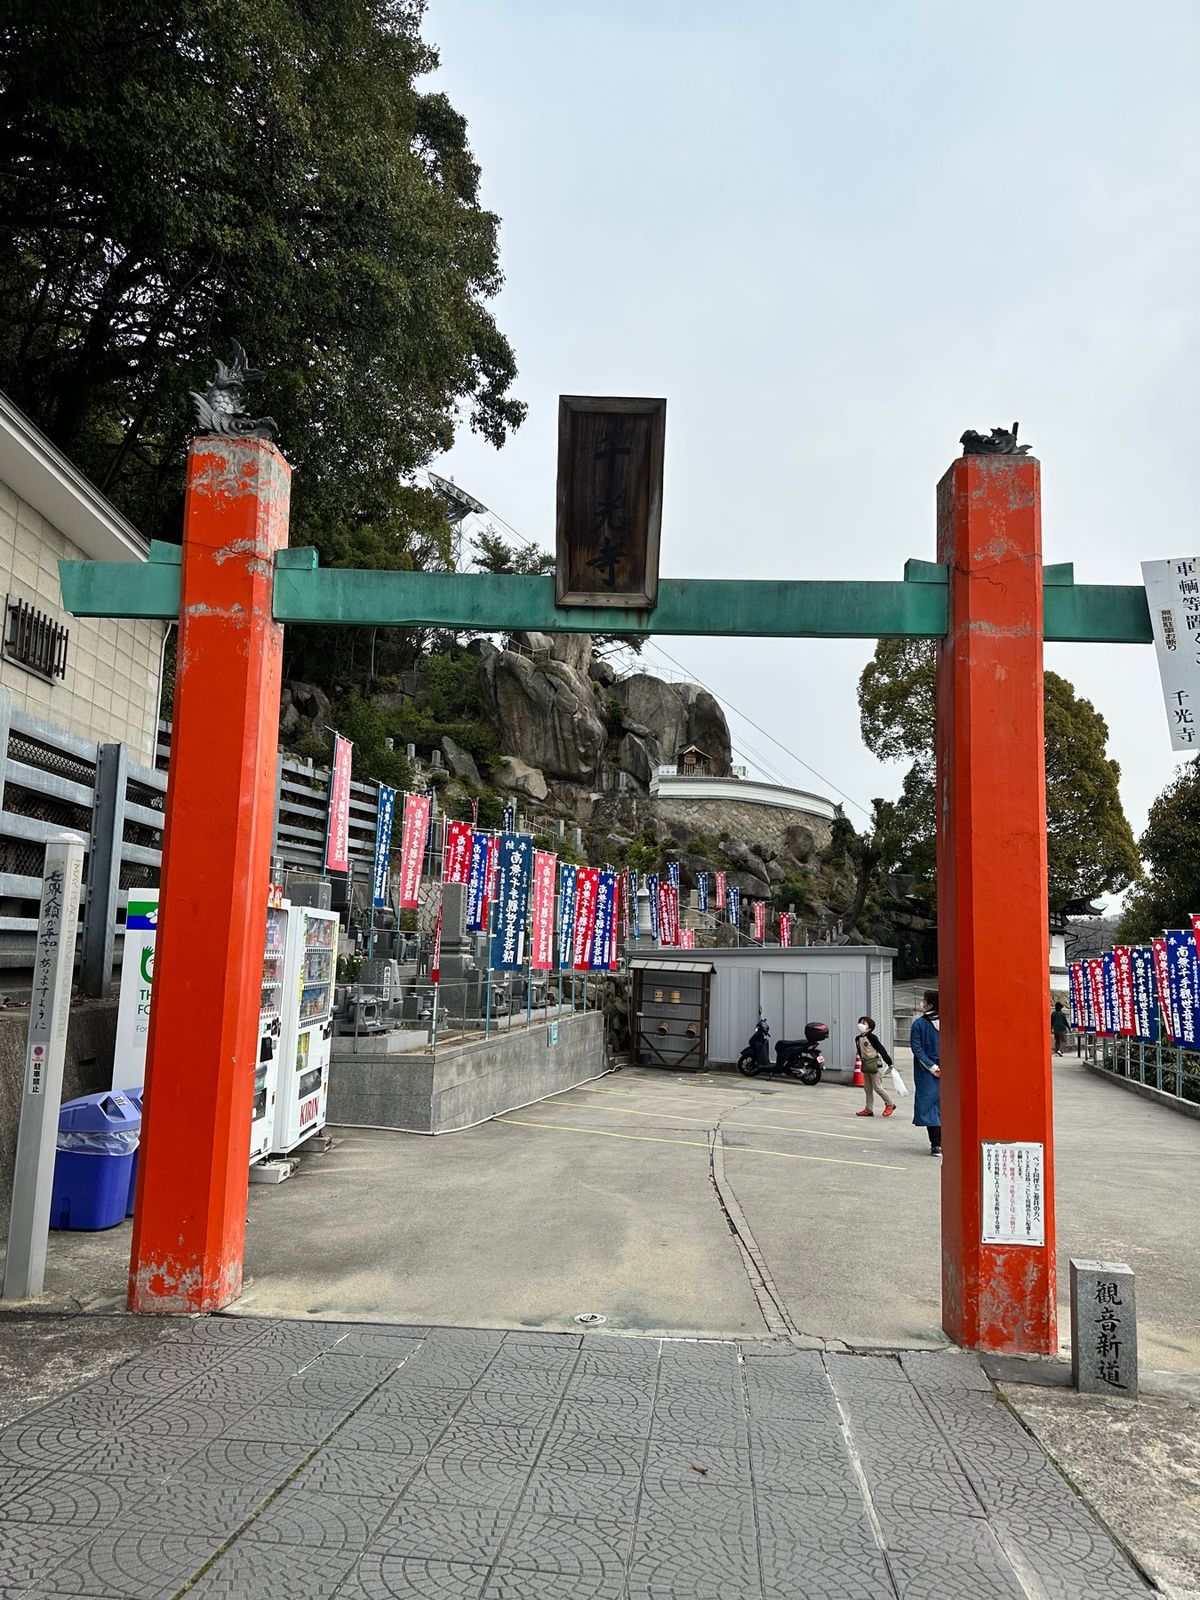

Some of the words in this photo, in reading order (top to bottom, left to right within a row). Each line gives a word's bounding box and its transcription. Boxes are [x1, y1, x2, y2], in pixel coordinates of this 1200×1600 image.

[1169, 690, 1196, 743] 千光寺
[299, 1096, 320, 1127] KIRIN
[1094, 1280, 1127, 1389] 観音新道
